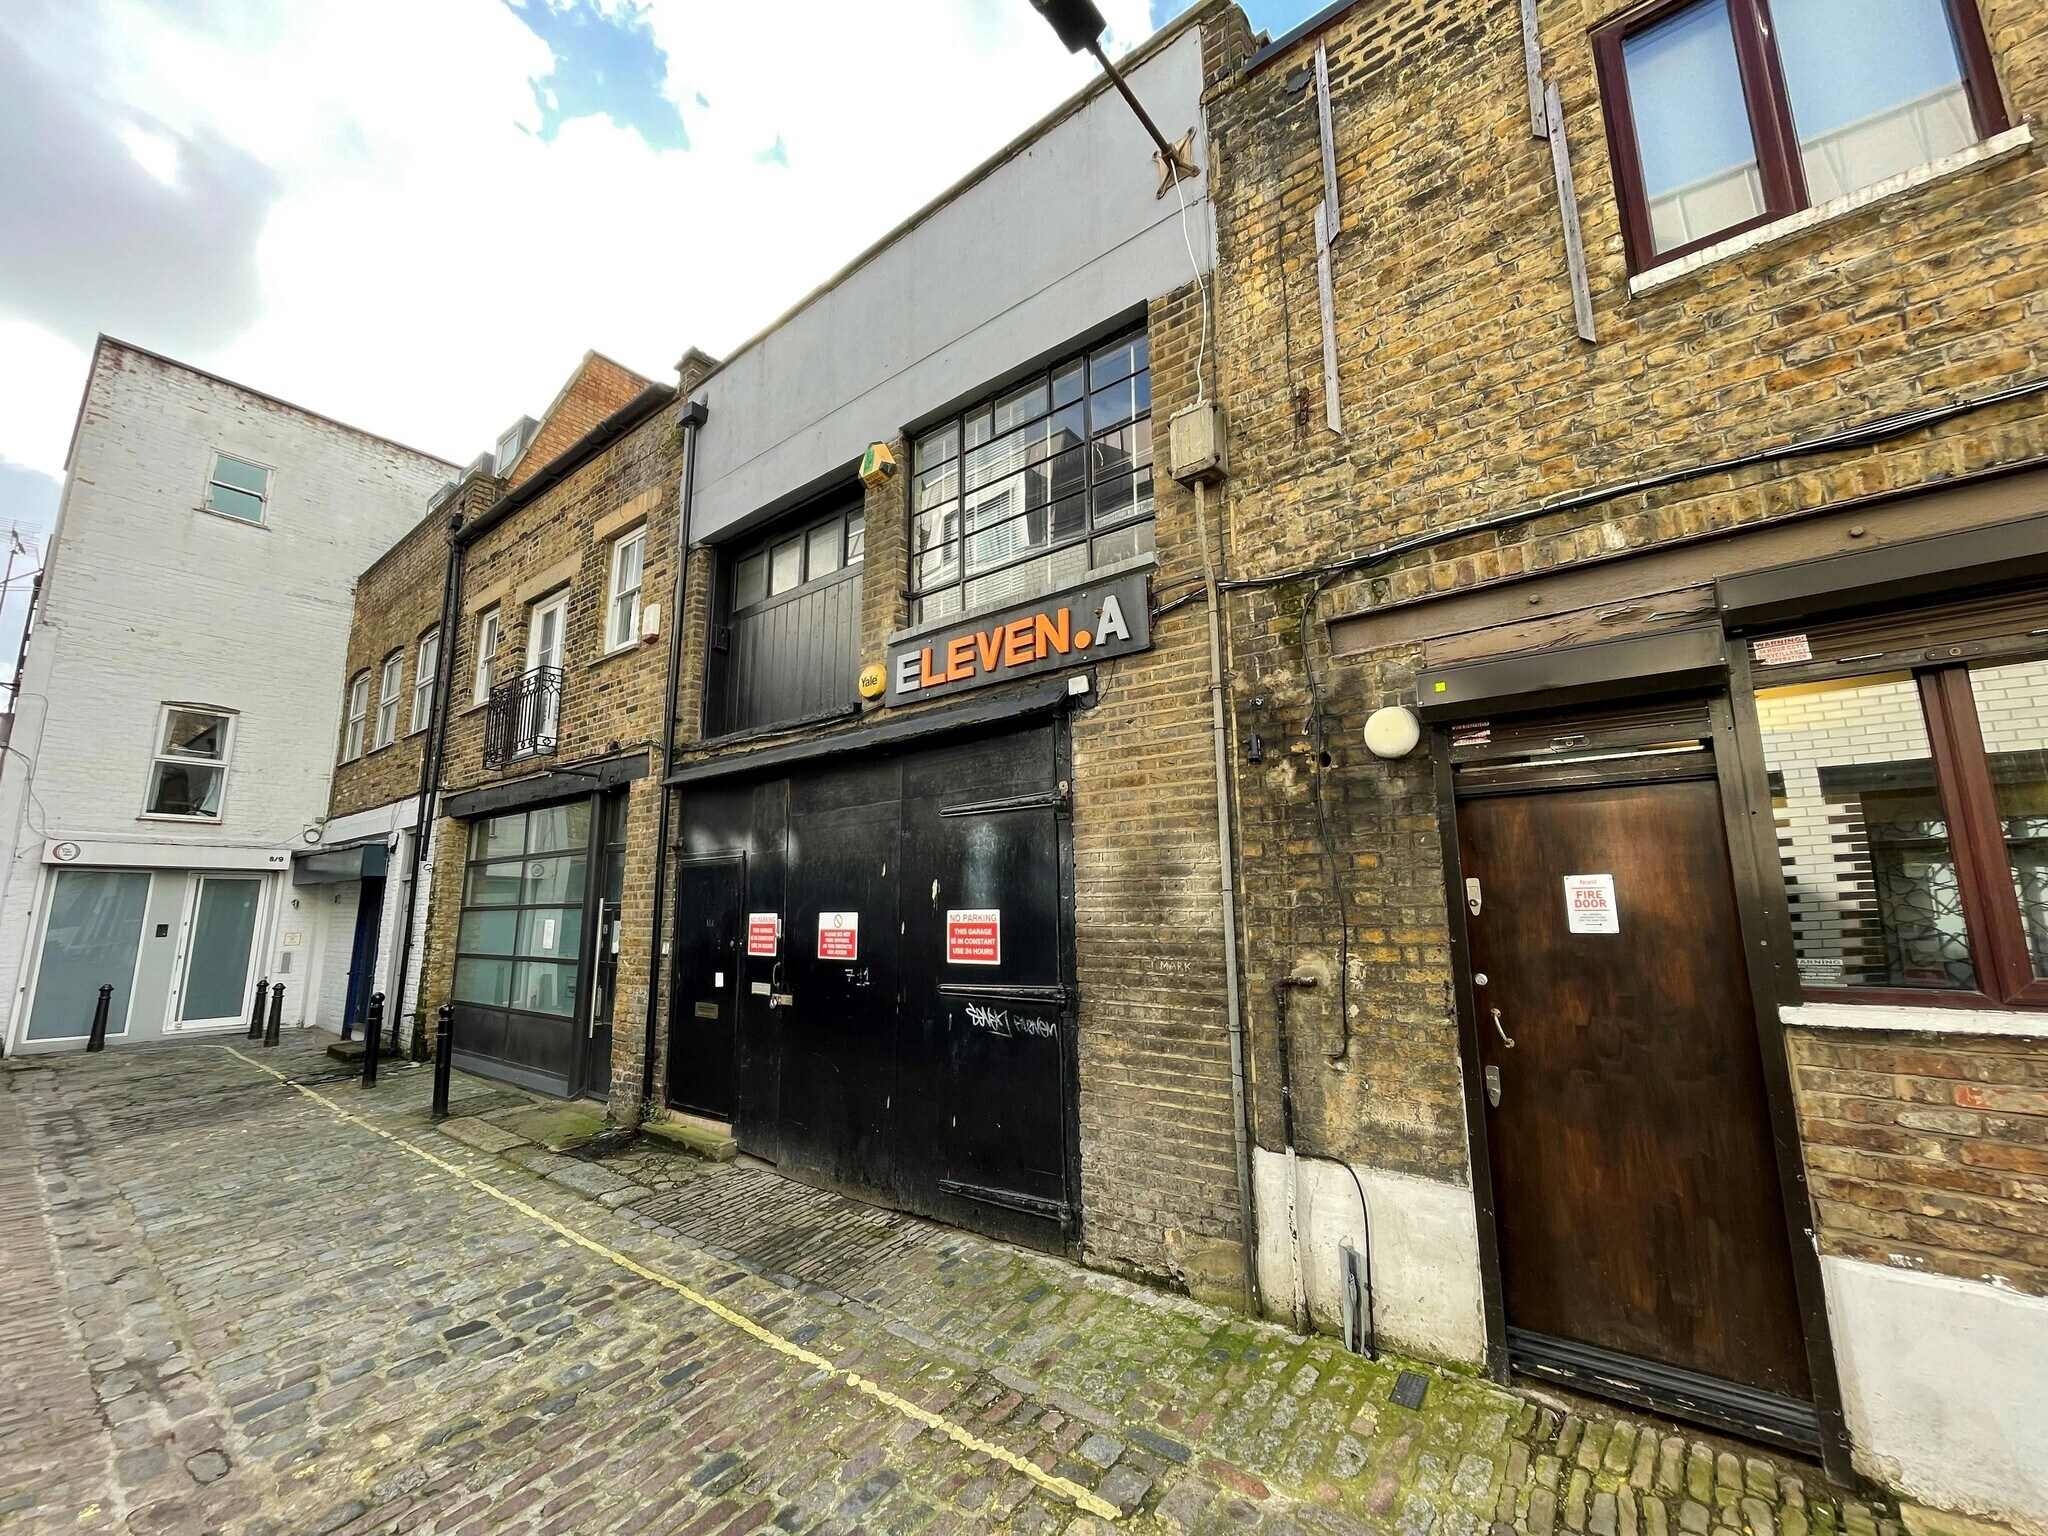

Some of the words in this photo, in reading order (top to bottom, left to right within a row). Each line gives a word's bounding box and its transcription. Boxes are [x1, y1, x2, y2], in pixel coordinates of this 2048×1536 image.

[1755, 637, 1804, 648] WARNING!
[1770, 654, 1808, 663] OPERATION
[861, 676, 878, 688] Yale
[1576, 890, 1603, 899] FIRE
[1574, 899, 1607, 908] DOOR
[949, 914, 961, 922] NO
[962, 914, 997, 922] PARKING
[972, 948, 994, 956] HOURS
[1159, 960, 1191, 971] MARK
